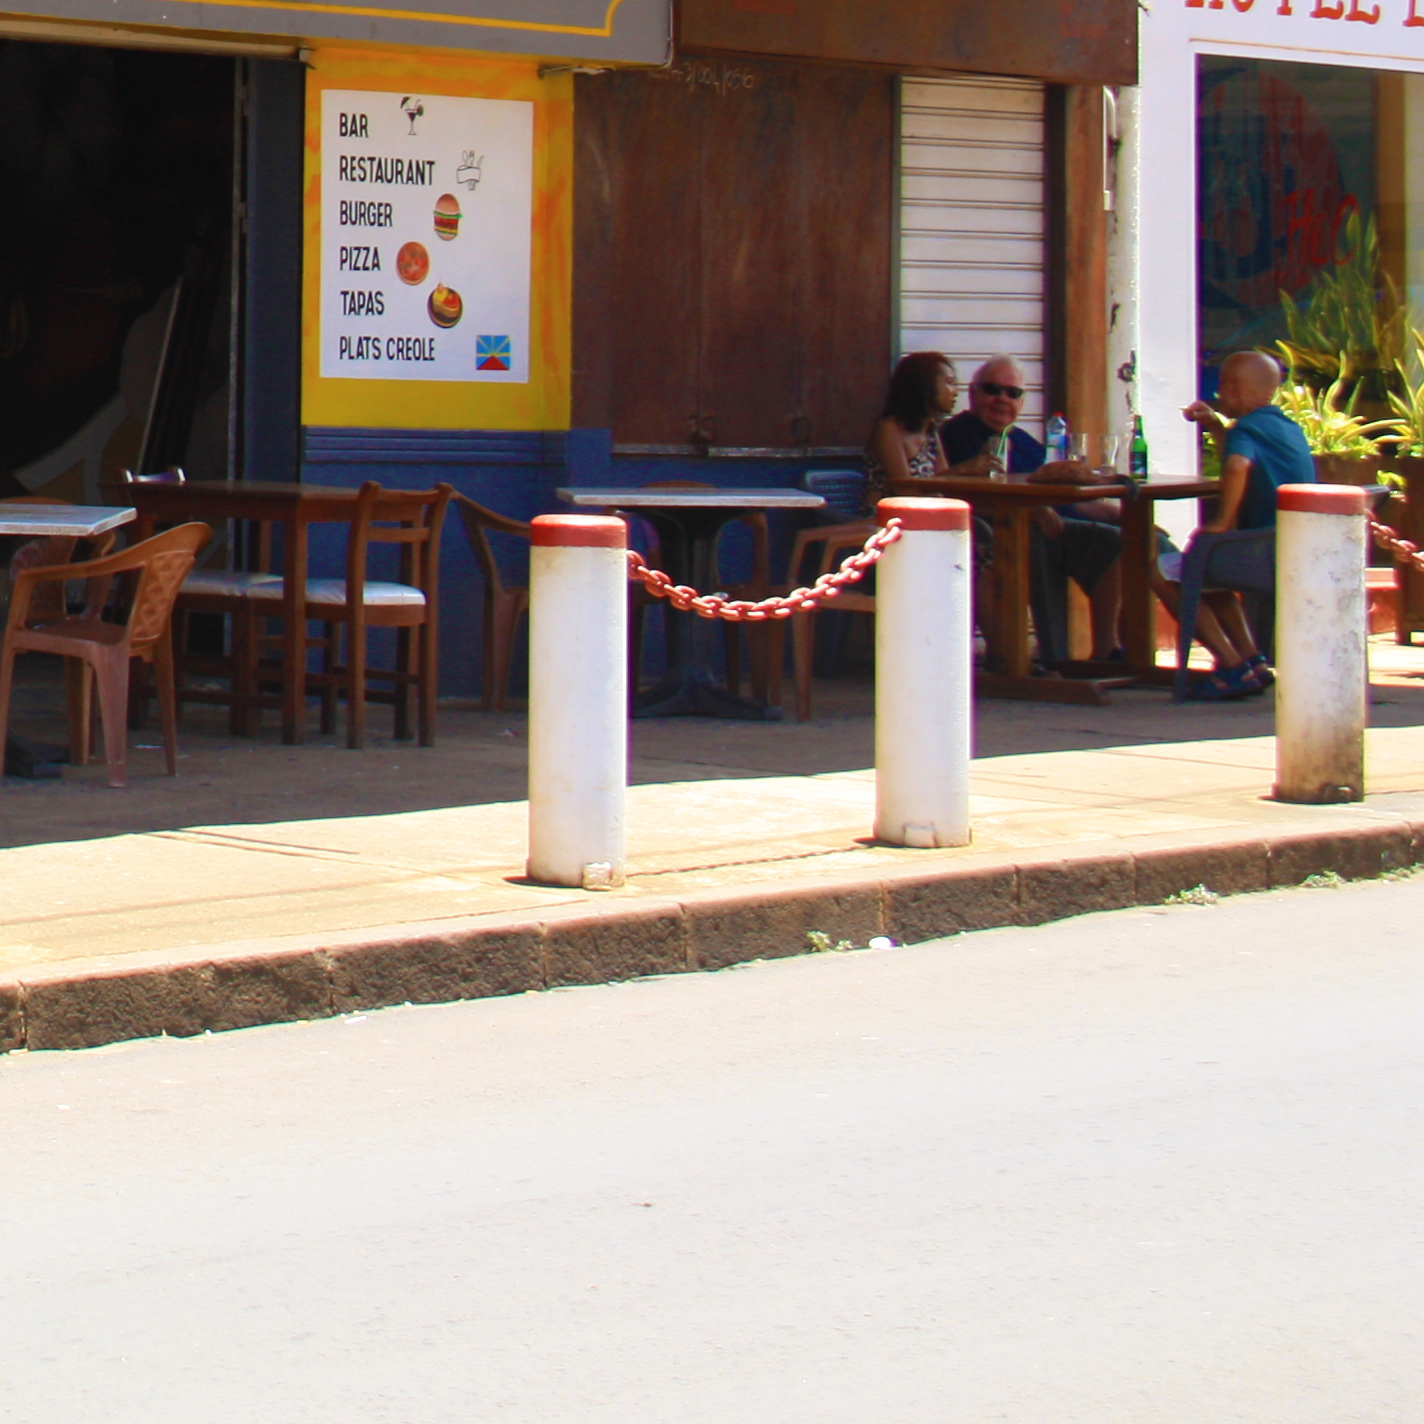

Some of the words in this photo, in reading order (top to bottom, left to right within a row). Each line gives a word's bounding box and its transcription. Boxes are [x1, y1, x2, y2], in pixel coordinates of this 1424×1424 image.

[339, 112, 369, 138] BAR
[339, 155, 435, 185] RESTAURANT
[339, 200, 393, 227] BURGER
[339, 246, 381, 271] PIZZA
[340, 290, 385, 316] TAPAS
[339, 336, 381, 360] PLATS
[386, 337, 435, 361] CREOLE
